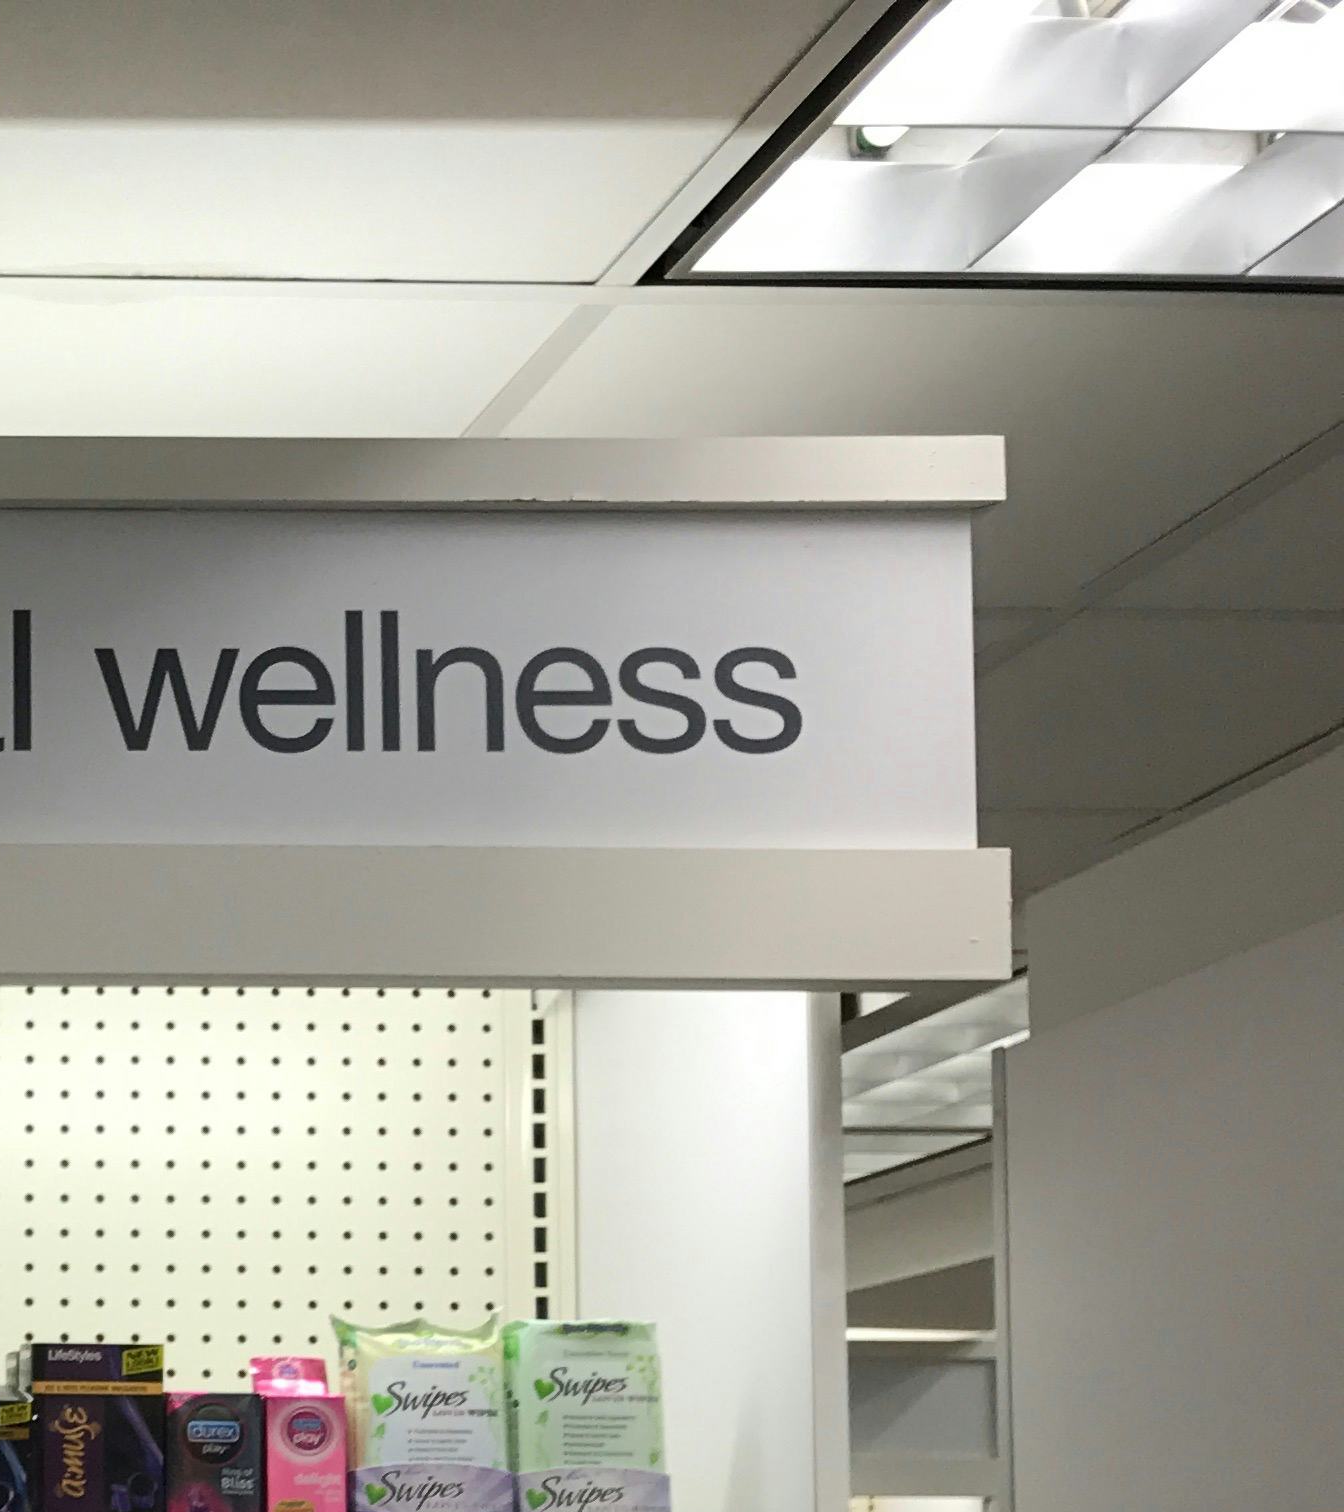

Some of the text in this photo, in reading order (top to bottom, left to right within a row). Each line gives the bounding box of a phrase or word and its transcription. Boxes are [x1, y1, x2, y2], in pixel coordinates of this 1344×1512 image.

[94, 609, 804, 753] wellness
[48, 1349, 101, 1361] LifeStyles
[386, 1381, 468, 1416] Swipes
[380, 1471, 464, 1506] Swipes
